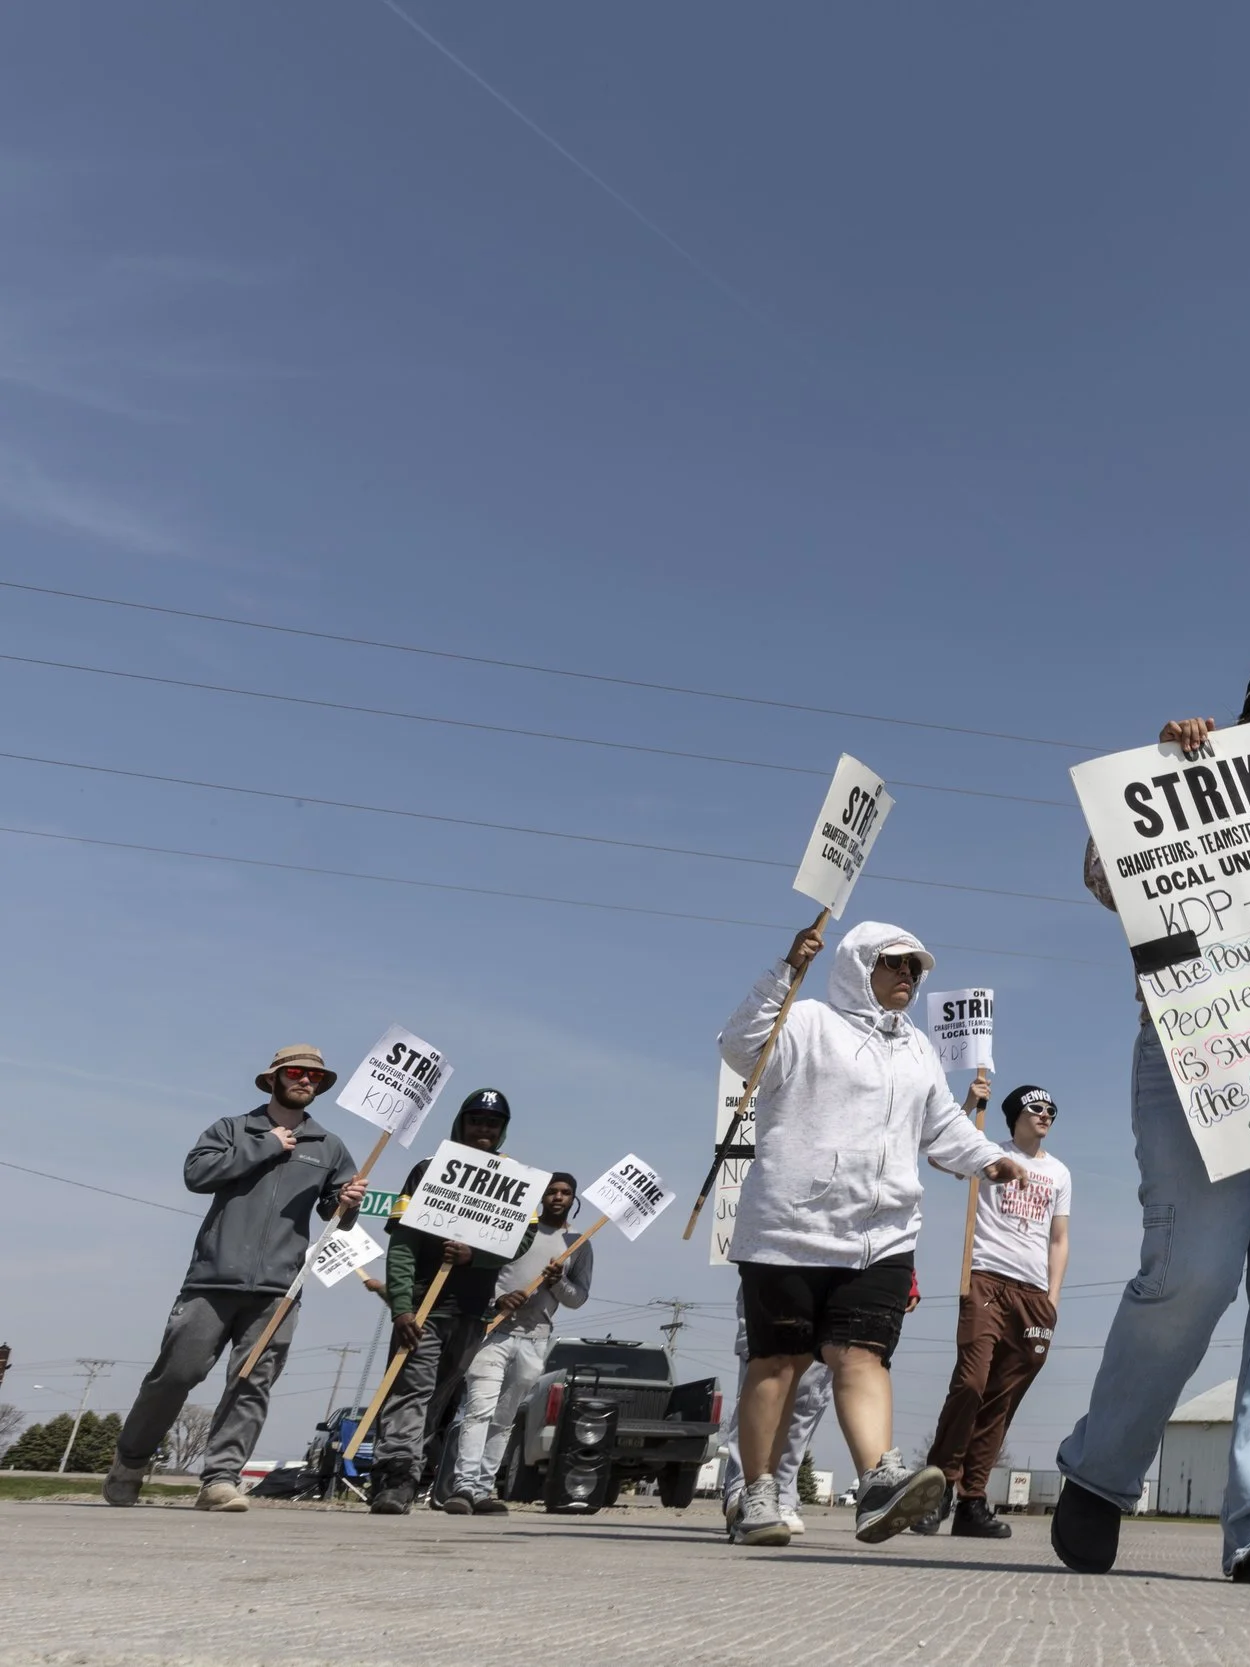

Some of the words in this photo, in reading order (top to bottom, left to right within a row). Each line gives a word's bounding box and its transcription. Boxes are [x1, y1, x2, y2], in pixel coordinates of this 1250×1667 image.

[821, 843, 844, 868] LOCAL
[1117, 840, 1198, 878] CHAUFFEURS,
[1142, 863, 1215, 900] LOCAL
[973, 990, 986, 998] ON
[942, 1028, 970, 1039] LOCAL
[430, 1051, 441, 1063] ON
[370, 1069, 402, 1092] LOCAL
[361, 1085, 405, 1121] KDP
[1190, 1084, 1247, 1123] the
[487, 1159, 501, 1170] ON
[647, 1171, 657, 1180] ON
[441, 1159, 531, 1207] STRIKE
[607, 1177, 625, 1193] LOCAL
[624, 1191, 640, 1208] UNION
[619, 1164, 664, 1206] STRIKE
[422, 1182, 461, 1203] CHAUFFEURS,
[463, 1194, 496, 1214] TEAMSTERS
[495, 1206, 500, 1214] &
[500, 1207, 528, 1223] HELPERS
[424, 1195, 456, 1214] LOCAL
[458, 1204, 491, 1225] UNION
[491, 1218, 514, 1232] 238
